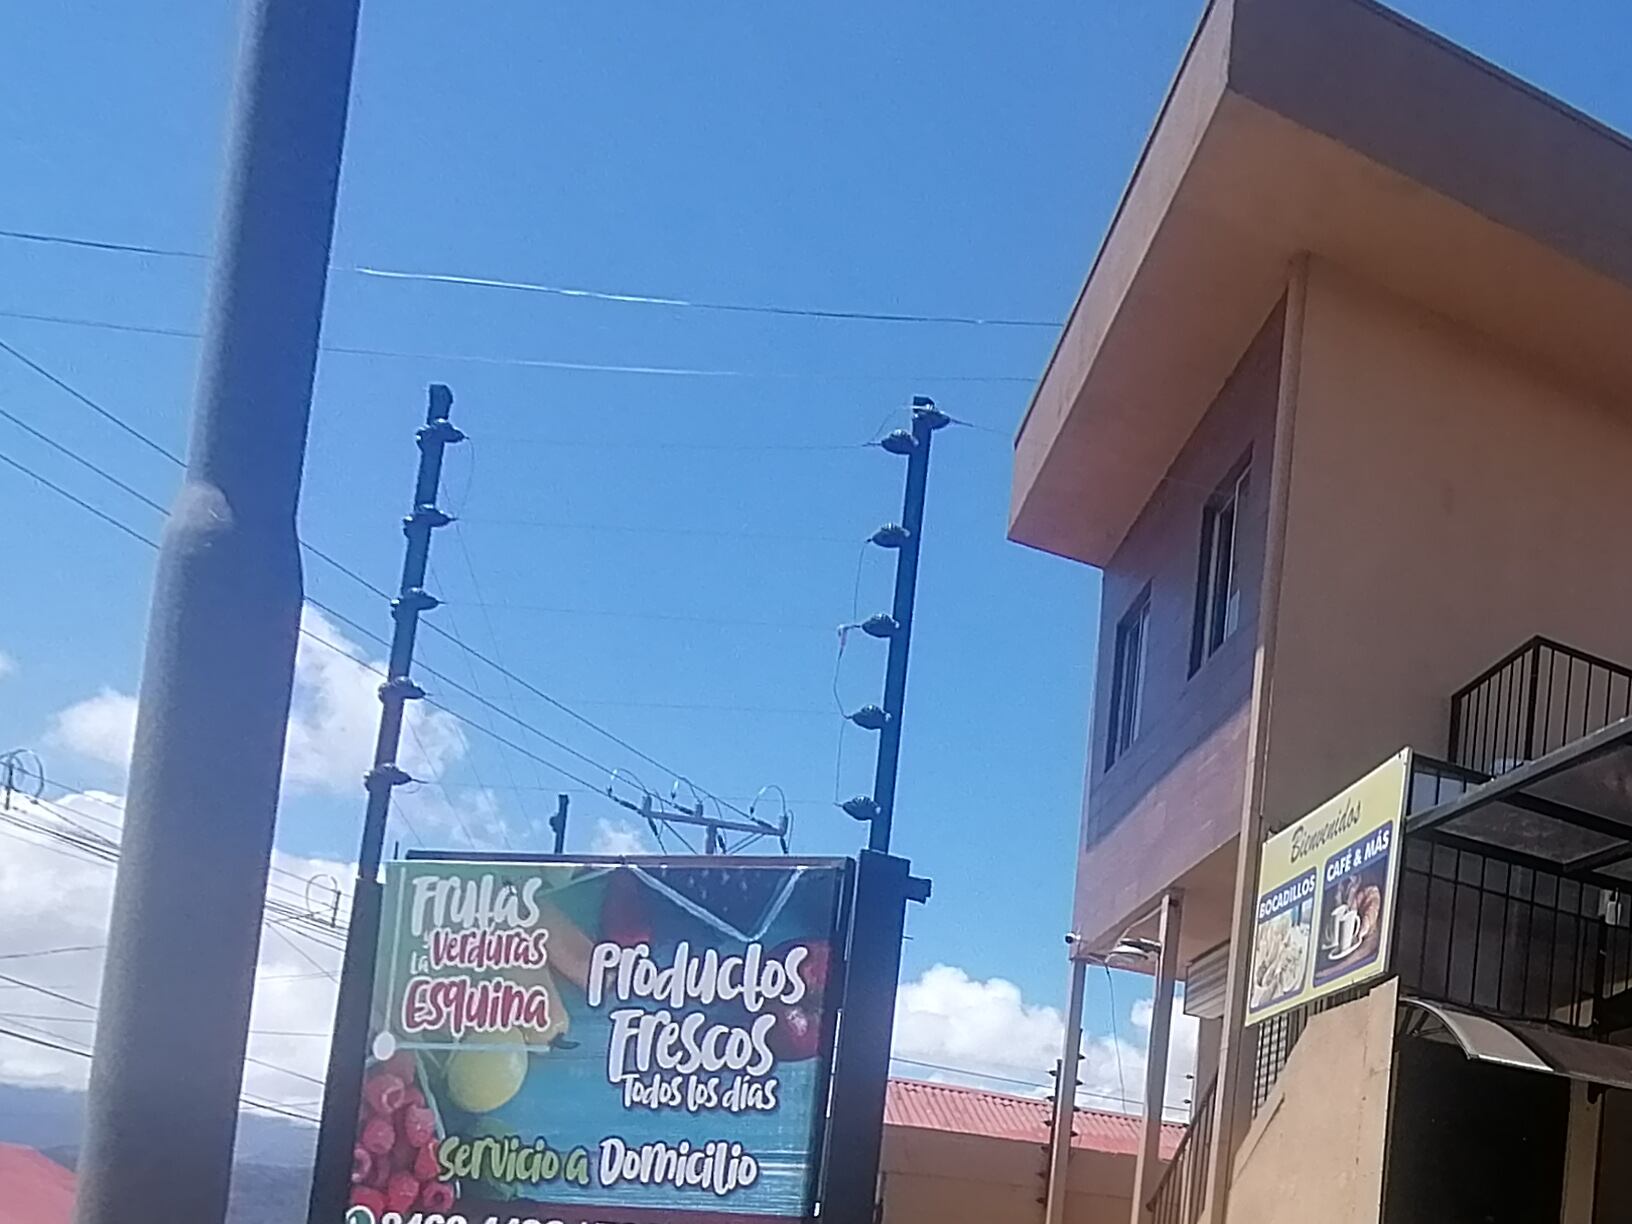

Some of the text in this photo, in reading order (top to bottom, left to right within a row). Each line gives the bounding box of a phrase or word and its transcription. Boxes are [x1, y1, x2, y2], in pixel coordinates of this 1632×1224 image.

[1290, 798, 1362, 864] Bienvenidos
[1326, 829, 1390, 882] CAFÉ & MÁS
[411, 874, 542, 936] Frutas
[1259, 874, 1316, 919] BOCADILLOS
[402, 975, 551, 1039] Esquina
[587, 941, 808, 1012] Productos
[606, 1007, 777, 1083] Frescos
[622, 1072, 777, 1112] Todos los días
[564, 1147, 590, 1185] a
[599, 1135, 759, 1195] Domicilio
